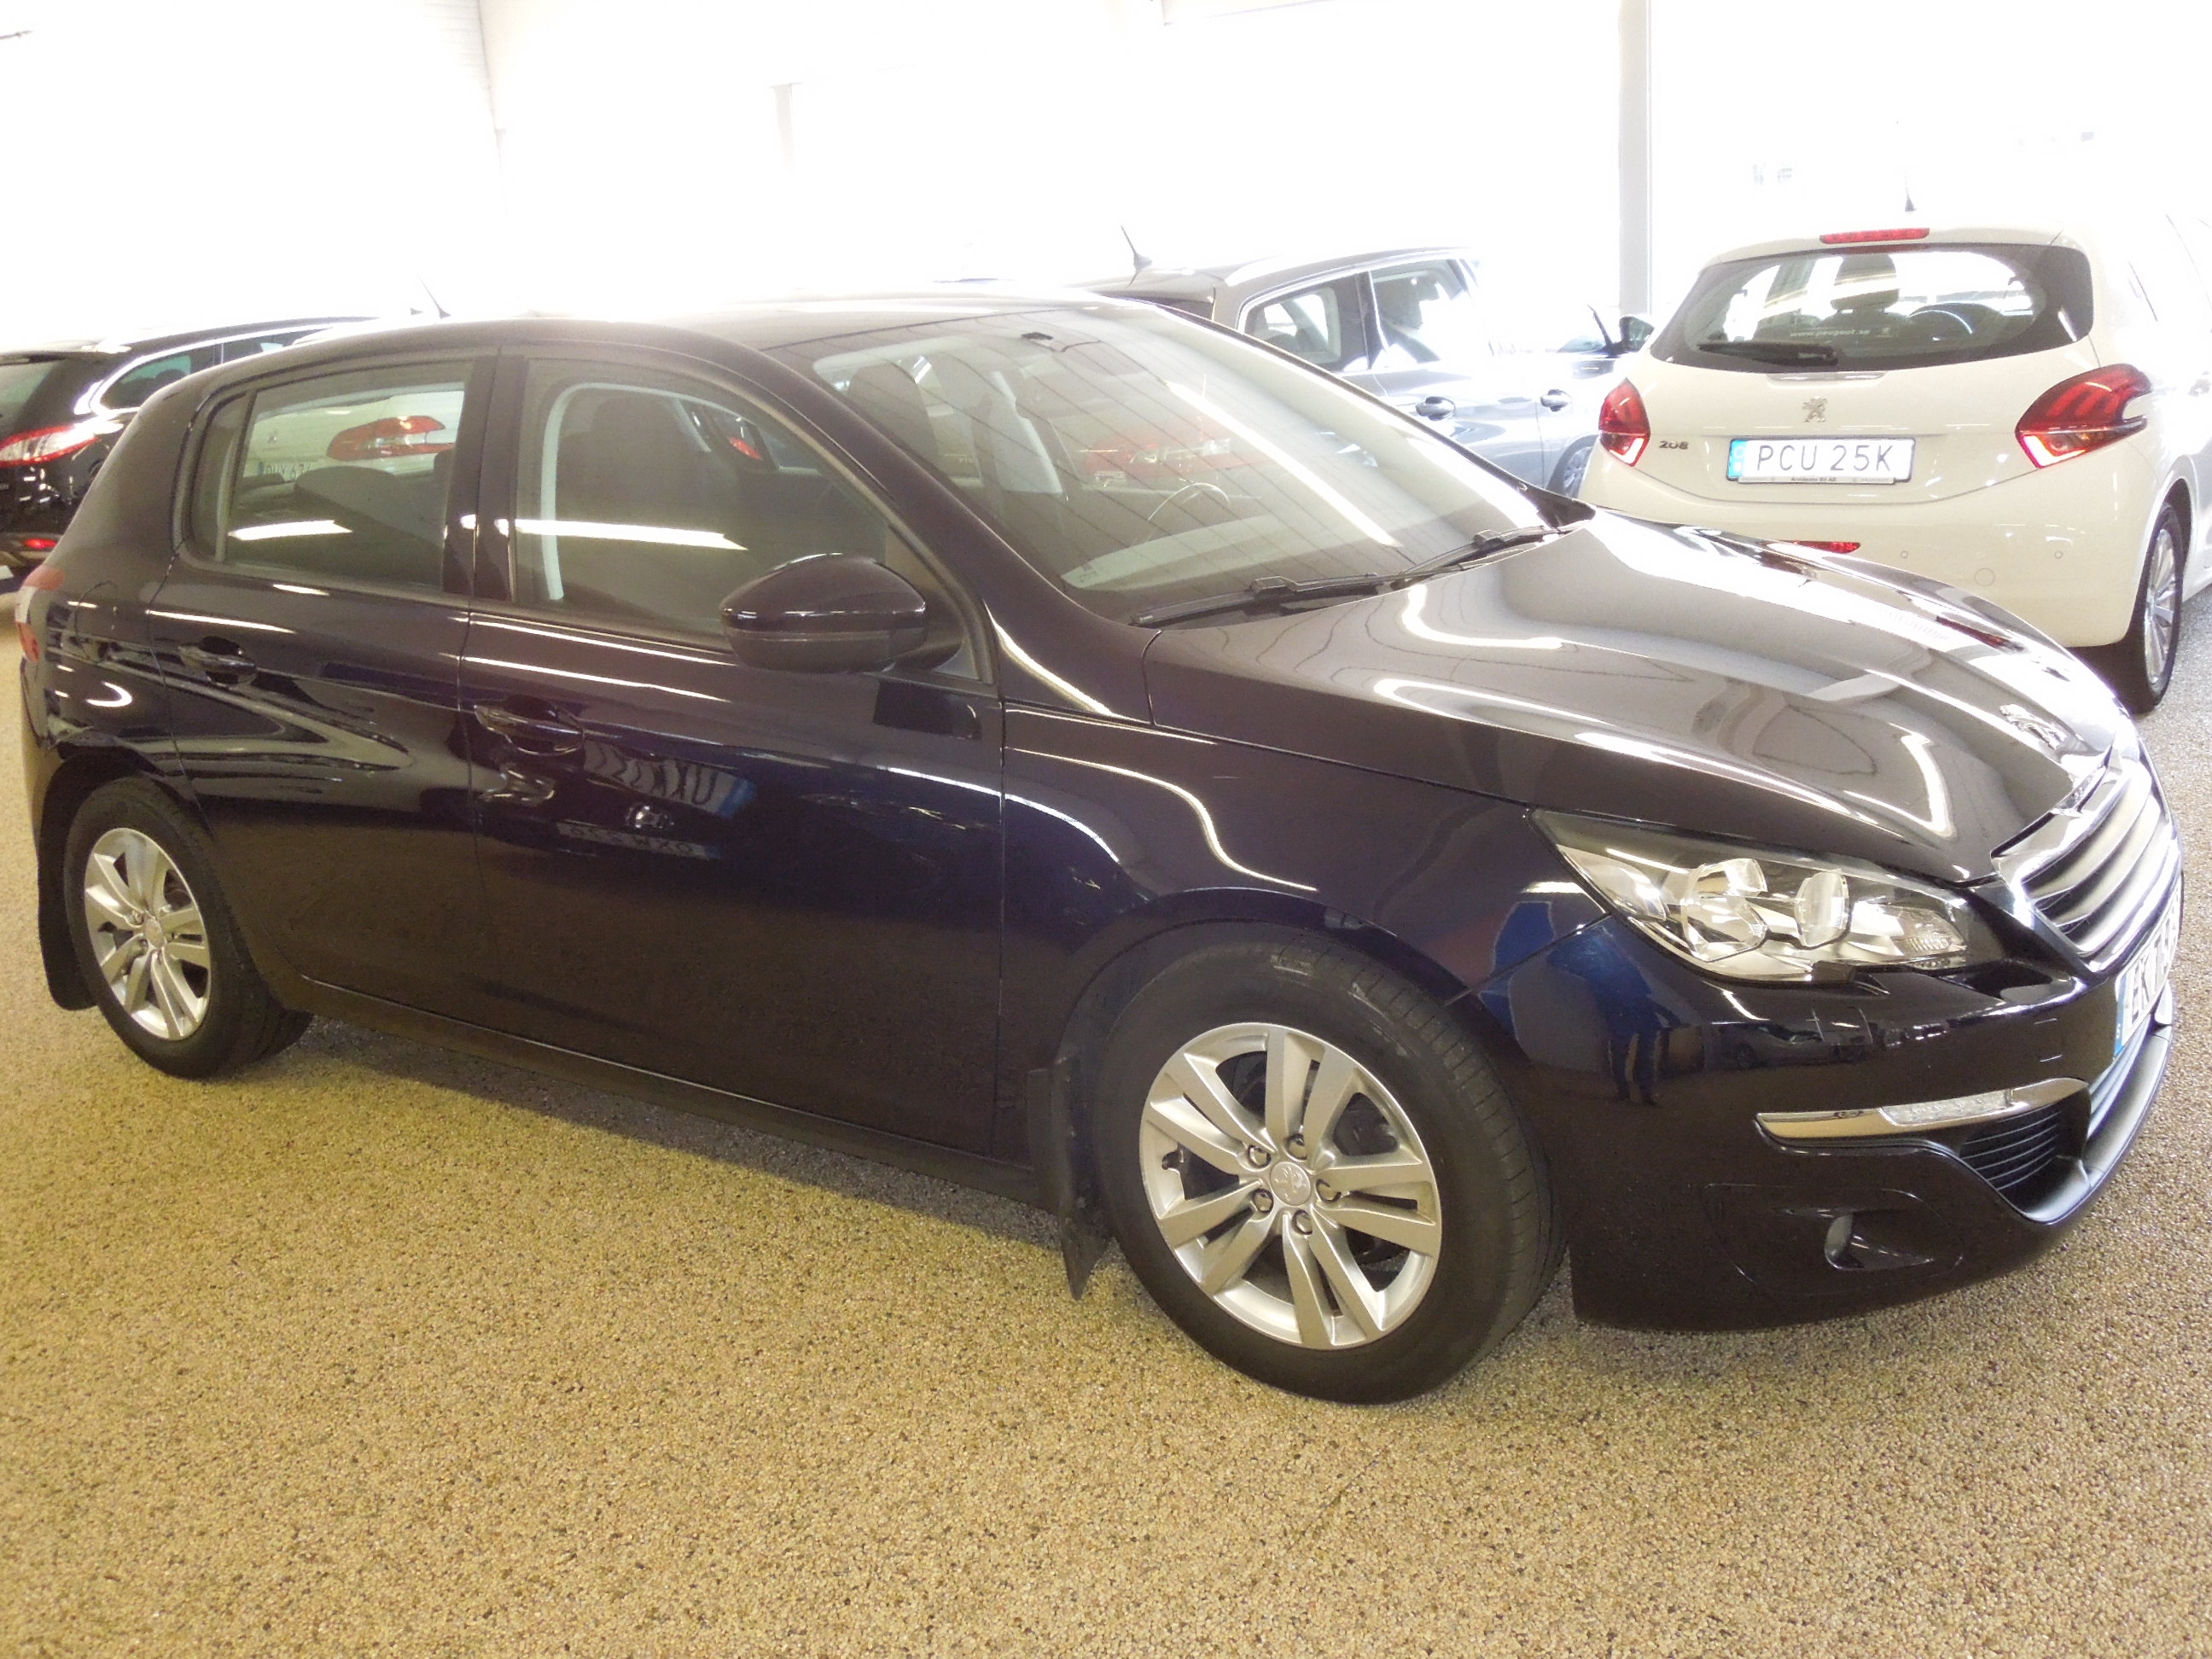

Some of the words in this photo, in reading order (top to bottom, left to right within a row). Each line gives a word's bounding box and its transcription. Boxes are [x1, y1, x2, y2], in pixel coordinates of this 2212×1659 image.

[1658, 440, 1688, 450] 208
[1757, 445, 1817, 471] PCU
[1830, 445, 1893, 471] 25K
